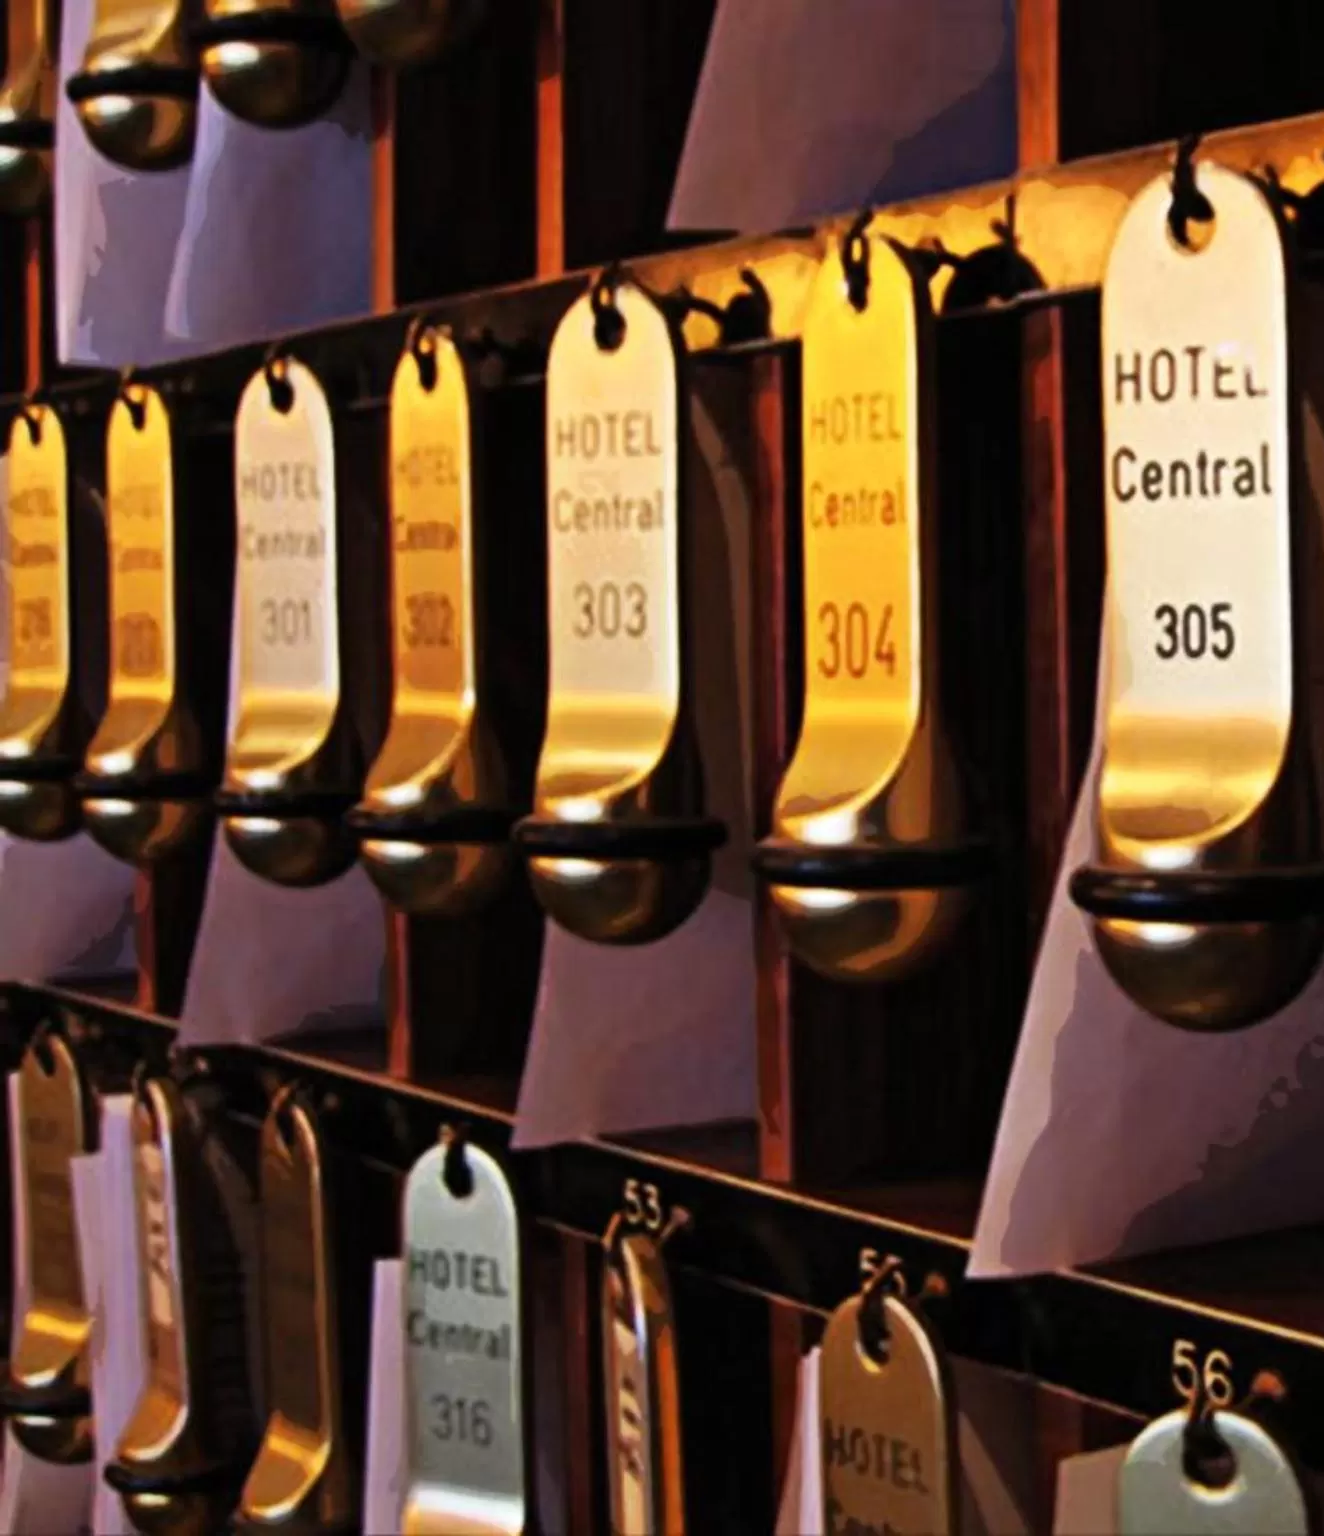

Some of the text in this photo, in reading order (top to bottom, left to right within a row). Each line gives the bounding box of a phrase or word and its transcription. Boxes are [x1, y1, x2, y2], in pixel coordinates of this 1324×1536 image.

[1115, 346, 1268, 404] HOTEL
[556, 410, 662, 460] HOTEL
[811, 391, 902, 445] HOTEL
[242, 461, 322, 501] HOTEL
[1112, 441, 1272, 503] Central
[554, 489, 665, 533] Central
[810, 475, 907, 528] Central
[243, 523, 326, 562] Central
[260, 598, 313, 647] 301
[573, 581, 648, 640] 303
[1154, 602, 1235, 660] 305
[816, 601, 896, 680] 304
[624, 1179, 662, 1230] 53
[409, 1247, 508, 1297] HOTEL
[1171, 1339, 1233, 1408] 56
[430, 1393, 494, 1448] 316
[823, 1416, 930, 1495] HOTEL
